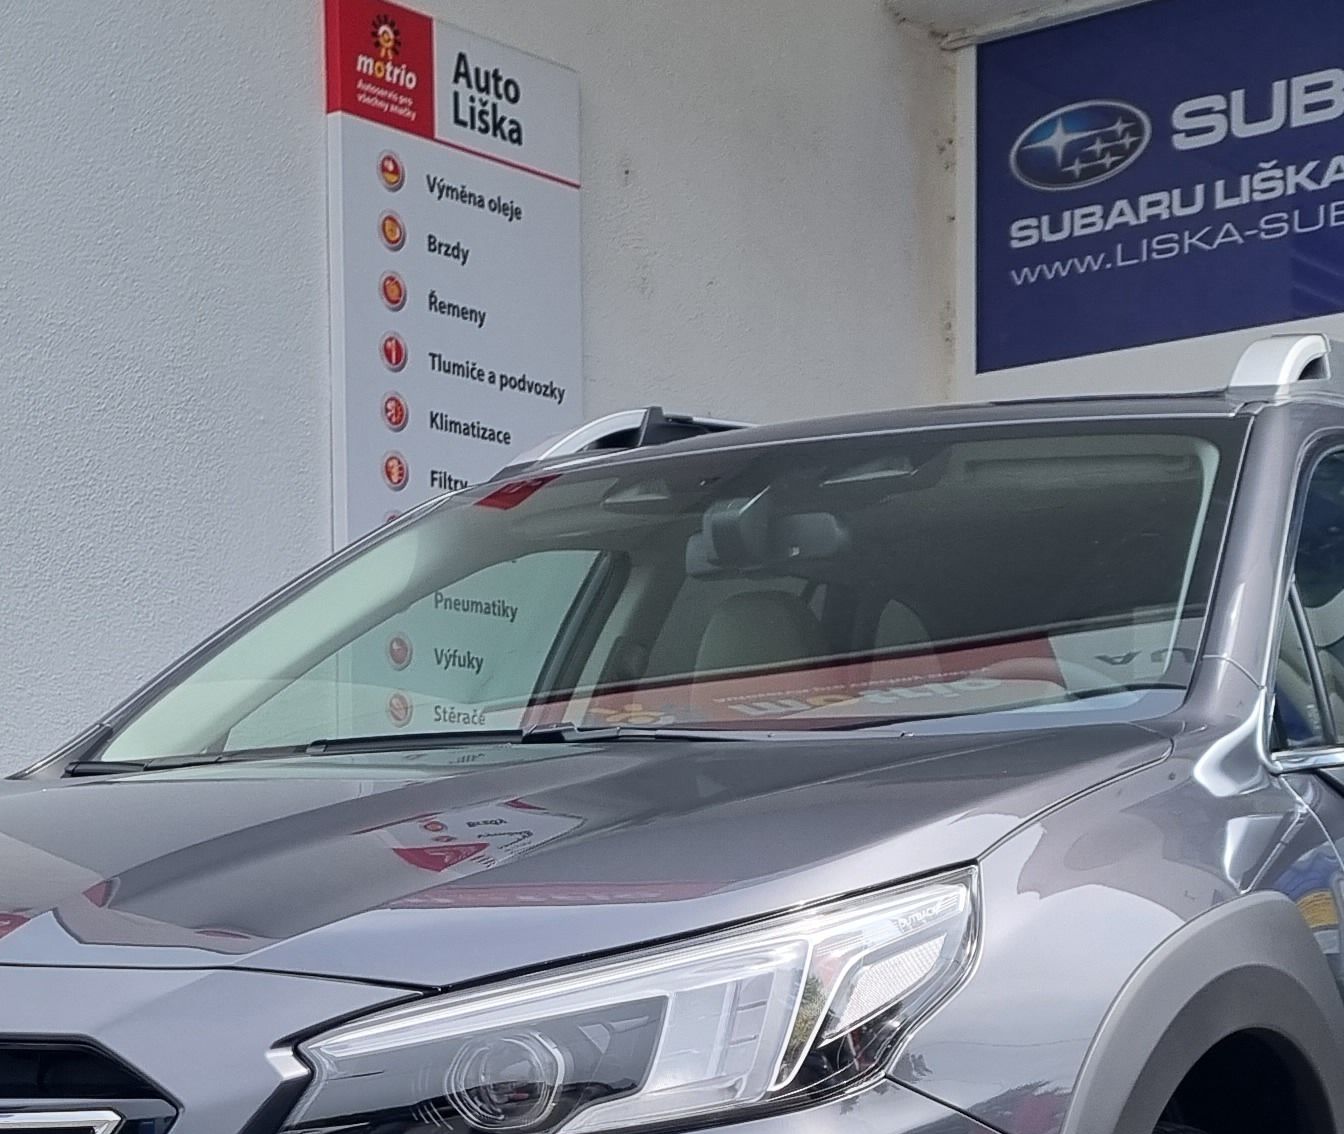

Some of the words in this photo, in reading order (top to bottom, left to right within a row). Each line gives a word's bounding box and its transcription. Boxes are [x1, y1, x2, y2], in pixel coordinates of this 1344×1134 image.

[357, 54, 417, 90] motrio
[453, 52, 520, 104] Auto
[453, 91, 523, 146] Liška
[426, 174, 485, 210] Výměna
[488, 196, 523, 222] oleje
[1010, 183, 1205, 249] SUBARU
[427, 234, 470, 266] Brzdy
[428, 290, 487, 328] Řemeny
[428, 352, 485, 382] Tlumiče
[488, 371, 497, 386] a
[499, 374, 566, 405] podvozky
[429, 411, 511, 445] Klimatizace
[430, 470, 469, 491] Filtry
[434, 592, 519, 623] Pneumatiky
[434, 648, 484, 674] Výfuky
[434, 705, 486, 726] Stěrače
